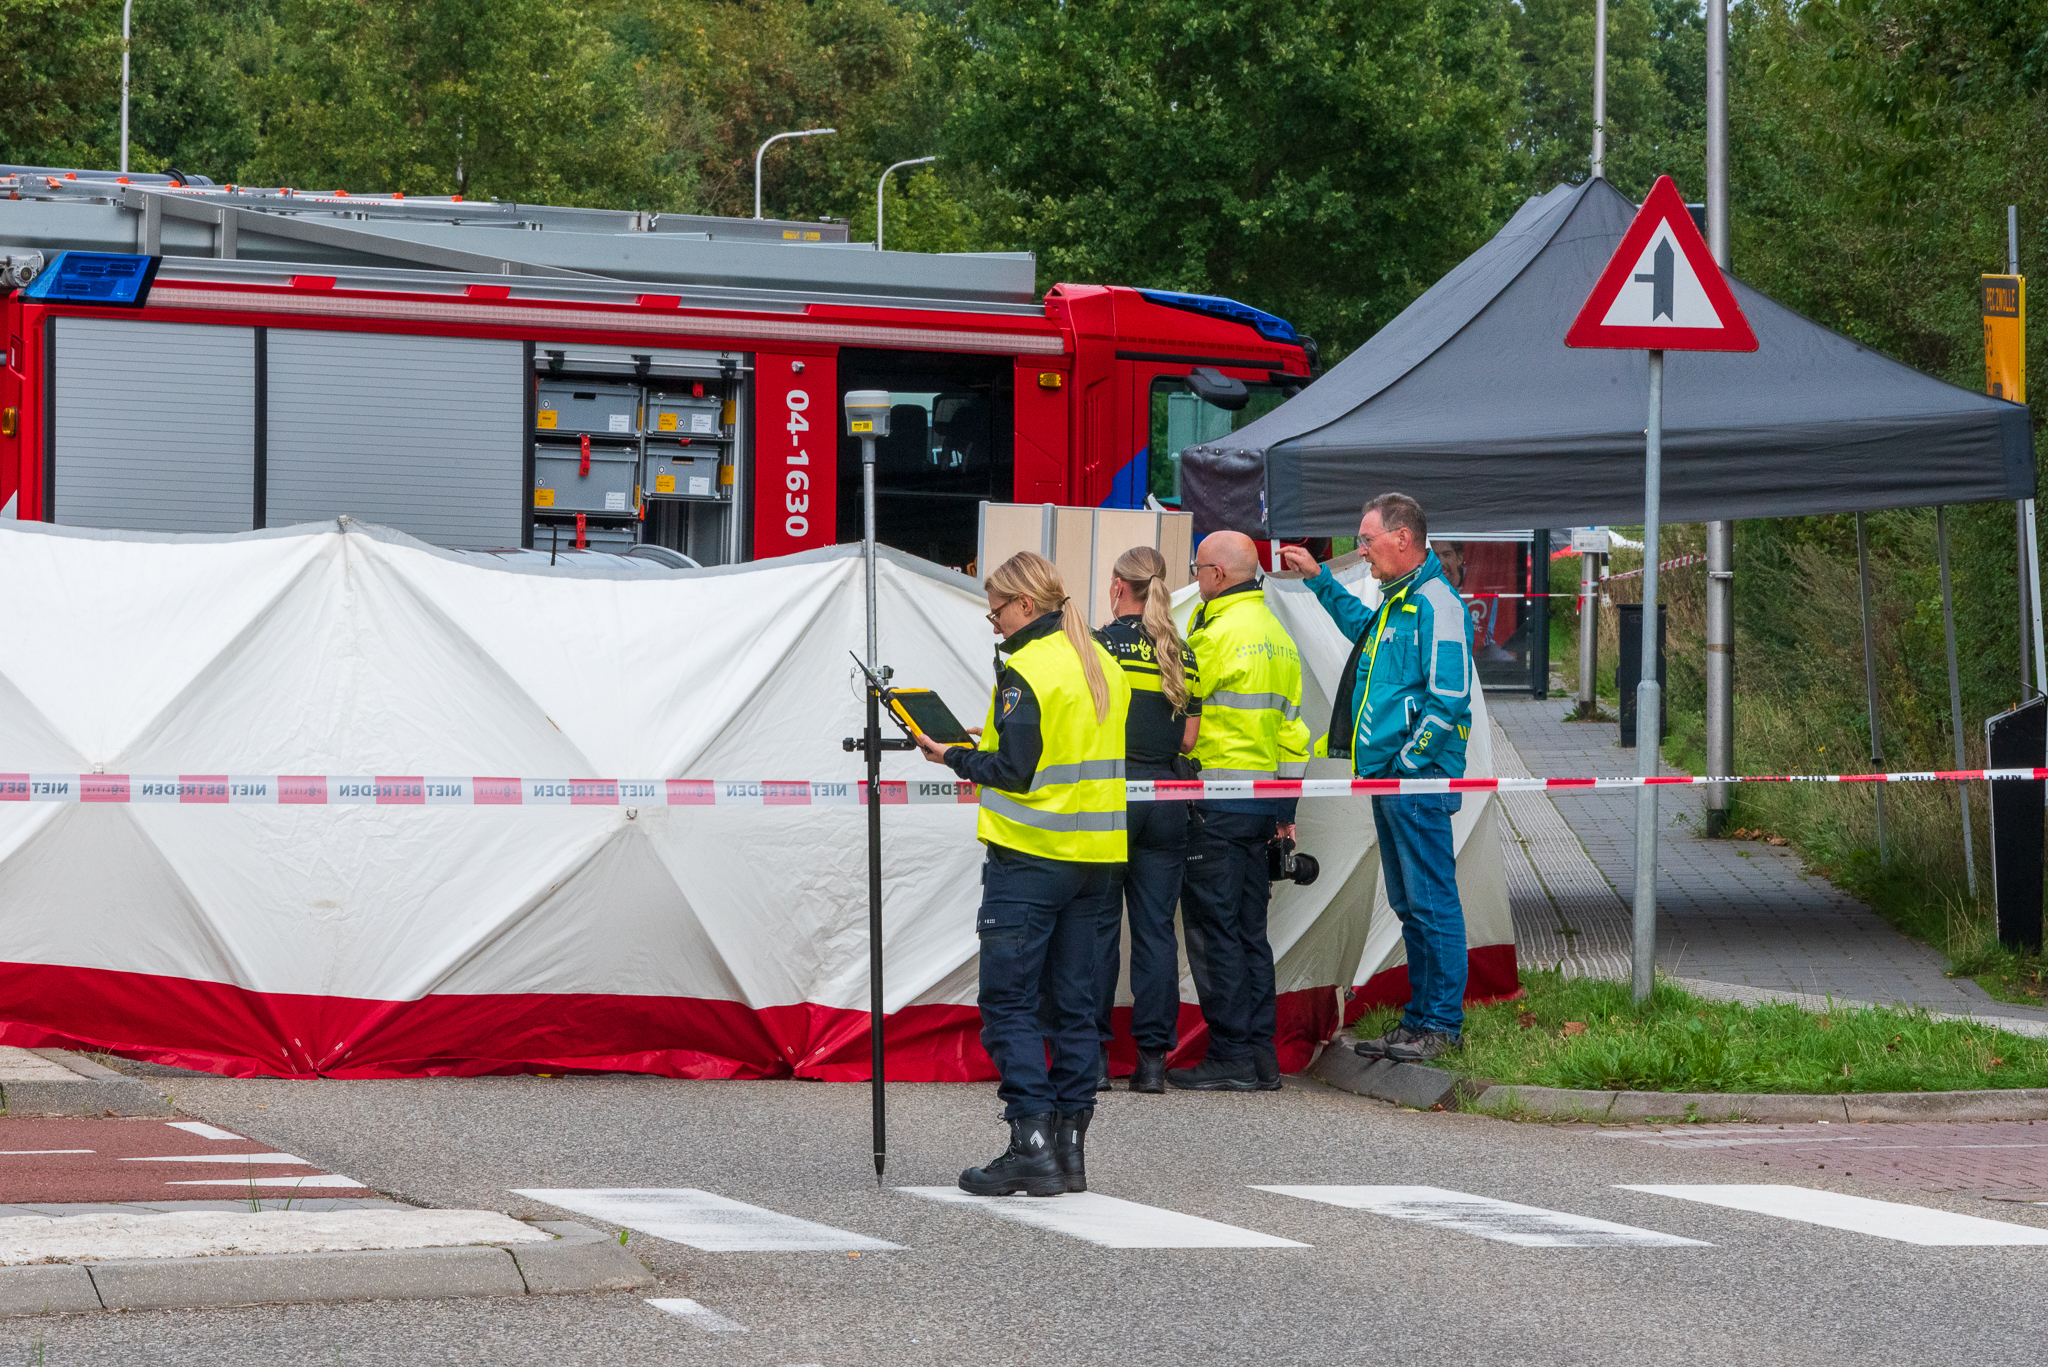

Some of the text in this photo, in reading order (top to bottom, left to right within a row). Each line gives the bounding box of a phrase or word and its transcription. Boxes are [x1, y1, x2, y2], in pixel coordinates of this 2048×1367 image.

[1996, 288, 2016, 312] ZWOLLE
[721, 351, 730, 359] K2
[785, 389, 810, 538] 04-1630
[1257, 634, 1293, 661] POLITIE
